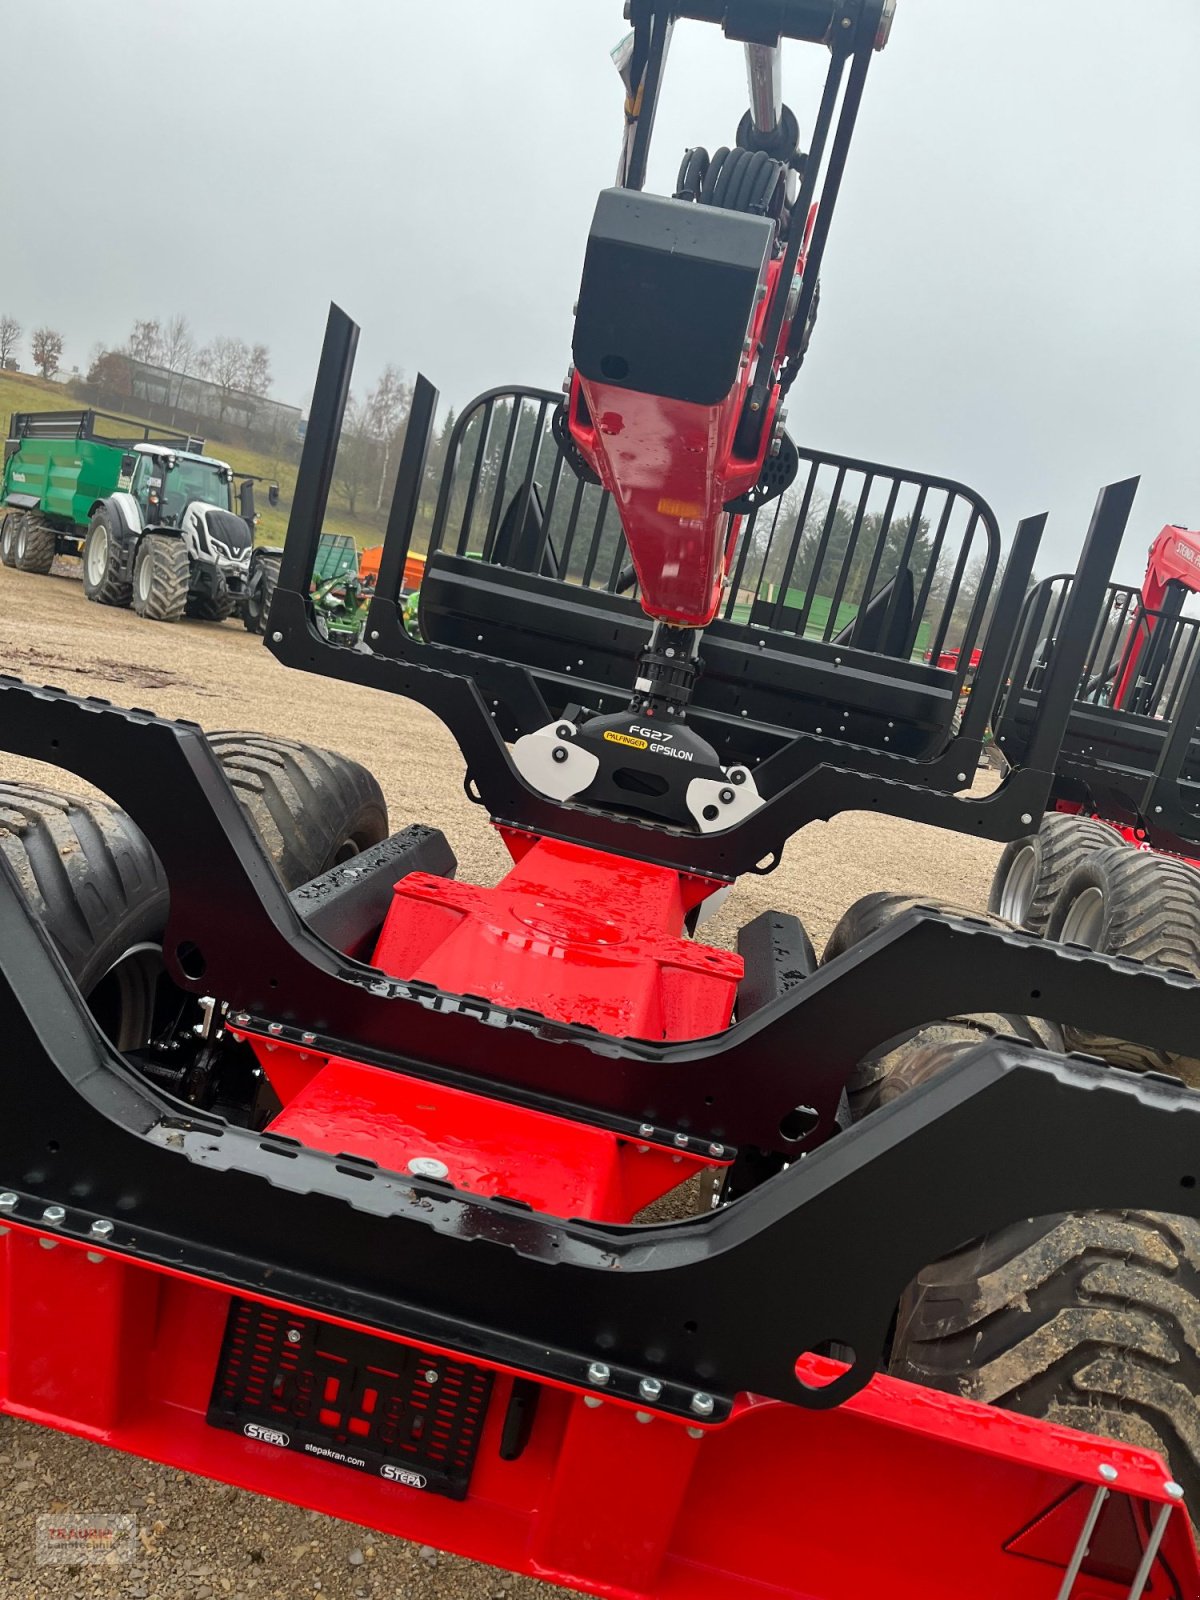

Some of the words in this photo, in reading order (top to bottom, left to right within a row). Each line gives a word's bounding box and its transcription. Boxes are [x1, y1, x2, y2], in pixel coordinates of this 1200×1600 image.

[606, 732, 645, 747] PALFINGER
[649, 743, 694, 761] EPSILON
[628, 725, 673, 742] FG27
[248, 1424, 285, 1446] STEPA
[304, 1442, 365, 1468] stepakran.com
[384, 1465, 422, 1488] STEPA
